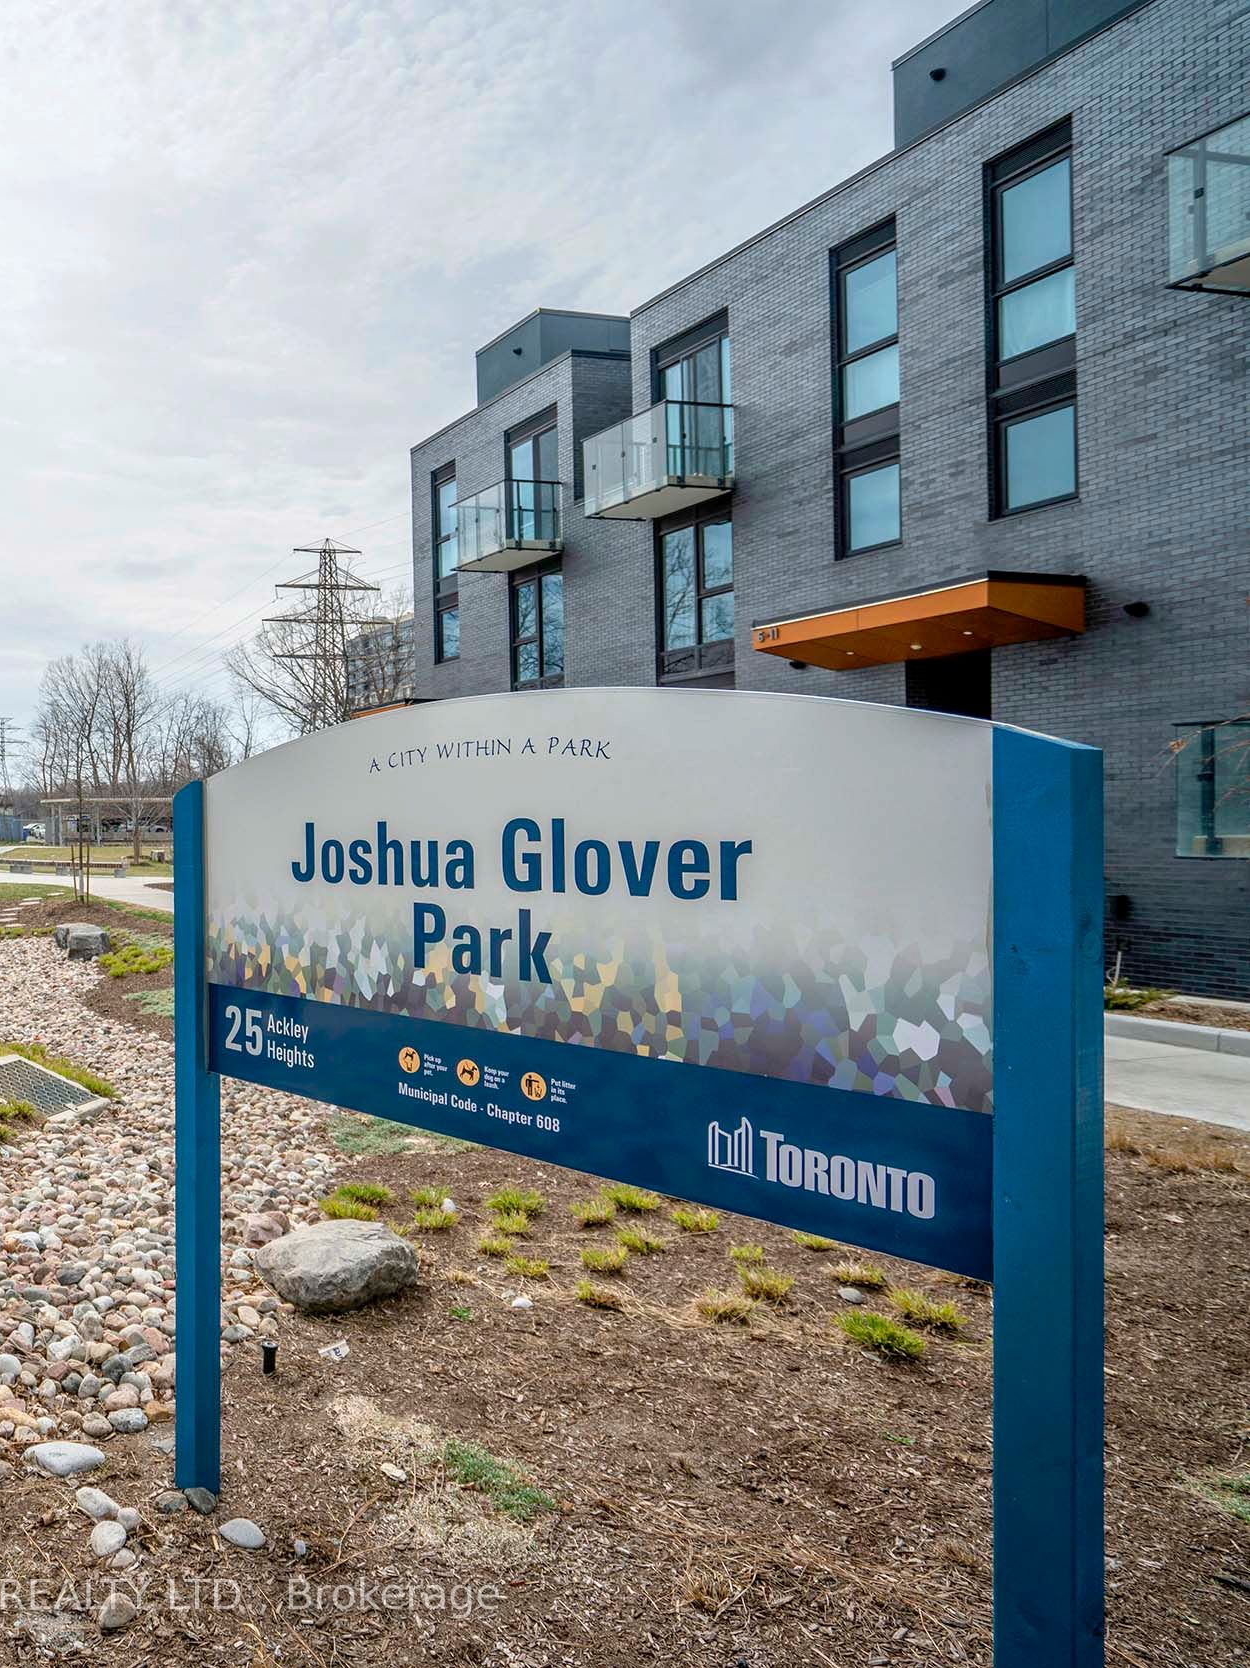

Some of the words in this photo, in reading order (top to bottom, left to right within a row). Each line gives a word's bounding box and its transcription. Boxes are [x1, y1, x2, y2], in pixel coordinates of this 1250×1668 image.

[369, 757, 381, 774] A
[388, 747, 427, 769] CITY
[436, 738, 511, 760] WITHIN
[521, 737, 537, 754] A
[547, 736, 612, 760] PARK
[291, 821, 475, 890] Joshua
[501, 817, 753, 901] Glover
[413, 901, 553, 985] Park
[225, 1005, 263, 1056] 25
[267, 1013, 309, 1044] Ackley
[267, 1039, 315, 1069] Heights
[398, 1081, 448, 1106] Municipal
[450, 1094, 477, 1113] Code
[487, 1103, 533, 1126] Chapter
[536, 1114, 561, 1133] 608
[759, 1129, 936, 1220] TORONTO
